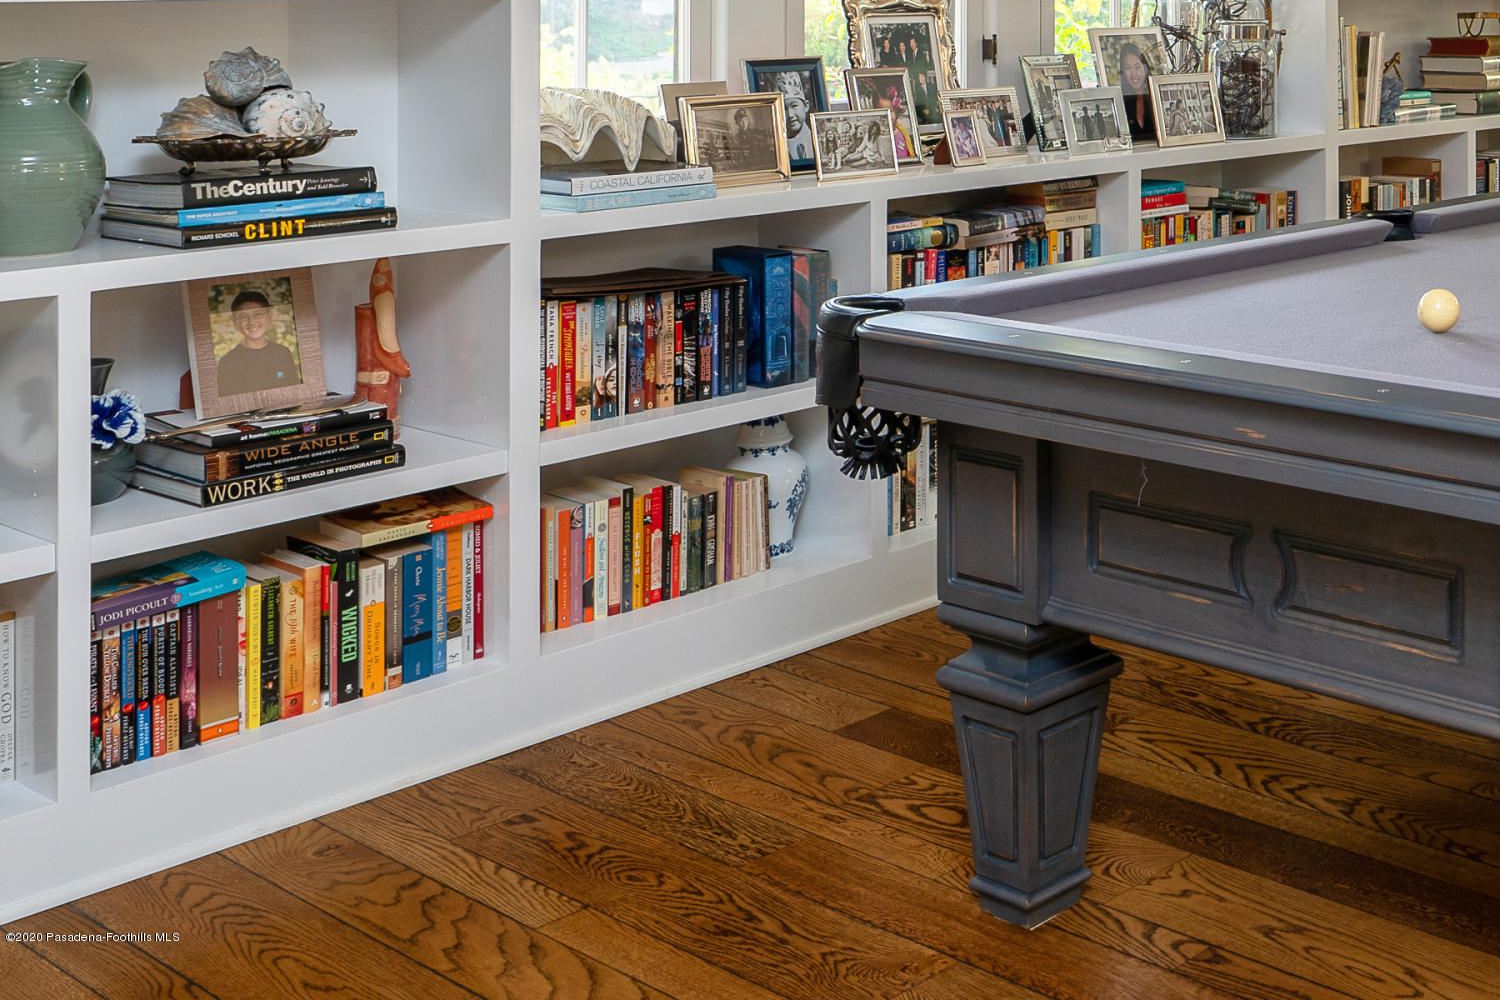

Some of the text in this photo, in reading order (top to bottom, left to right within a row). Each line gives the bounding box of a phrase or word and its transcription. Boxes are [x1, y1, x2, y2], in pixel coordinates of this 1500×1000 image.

[590, 170, 694, 191] COASTAL CALIFORNIA
[190, 231, 240, 242] RICHARD SCHICKEL
[244, 219, 306, 240] CLINT
[563, 328, 574, 370] SYMPATHIZER
[244, 432, 361, 462] WIDE ANGLE
[244, 461, 272, 470] NATIONAL
[273, 454, 310, 465] GEOGRAPHIC
[311, 449, 338, 458] GREATEST
[286, 459, 382, 483] THE WORLD IN PHOTOGRAPHS
[207, 475, 272, 504] WORK
[414, 566, 424, 587] Chute
[474, 554, 482, 575] JULIET
[436, 566, 446, 644] Jennie About to Be
[465, 557, 473, 625] DARK HARBOR HOUSE
[99, 596, 169, 626] JODI PICOULT
[290, 598, 298, 615] THE
[290, 637, 298, 658] WIFE
[341, 605, 358, 664] WICKED
[366, 610, 374, 680] ORDINARY TIME
[374, 621, 382, 651] SONGS
[1, 624, 12, 725] HOW TO KNOW GOD
[90, 643, 99, 676] PIRATES
[142, 629, 150, 700] THE SUN OVER BREDA
[157, 626, 165, 694] PURITY OF BLOOD
[169, 622, 178, 697] CAPTAIN ALATRISTE
